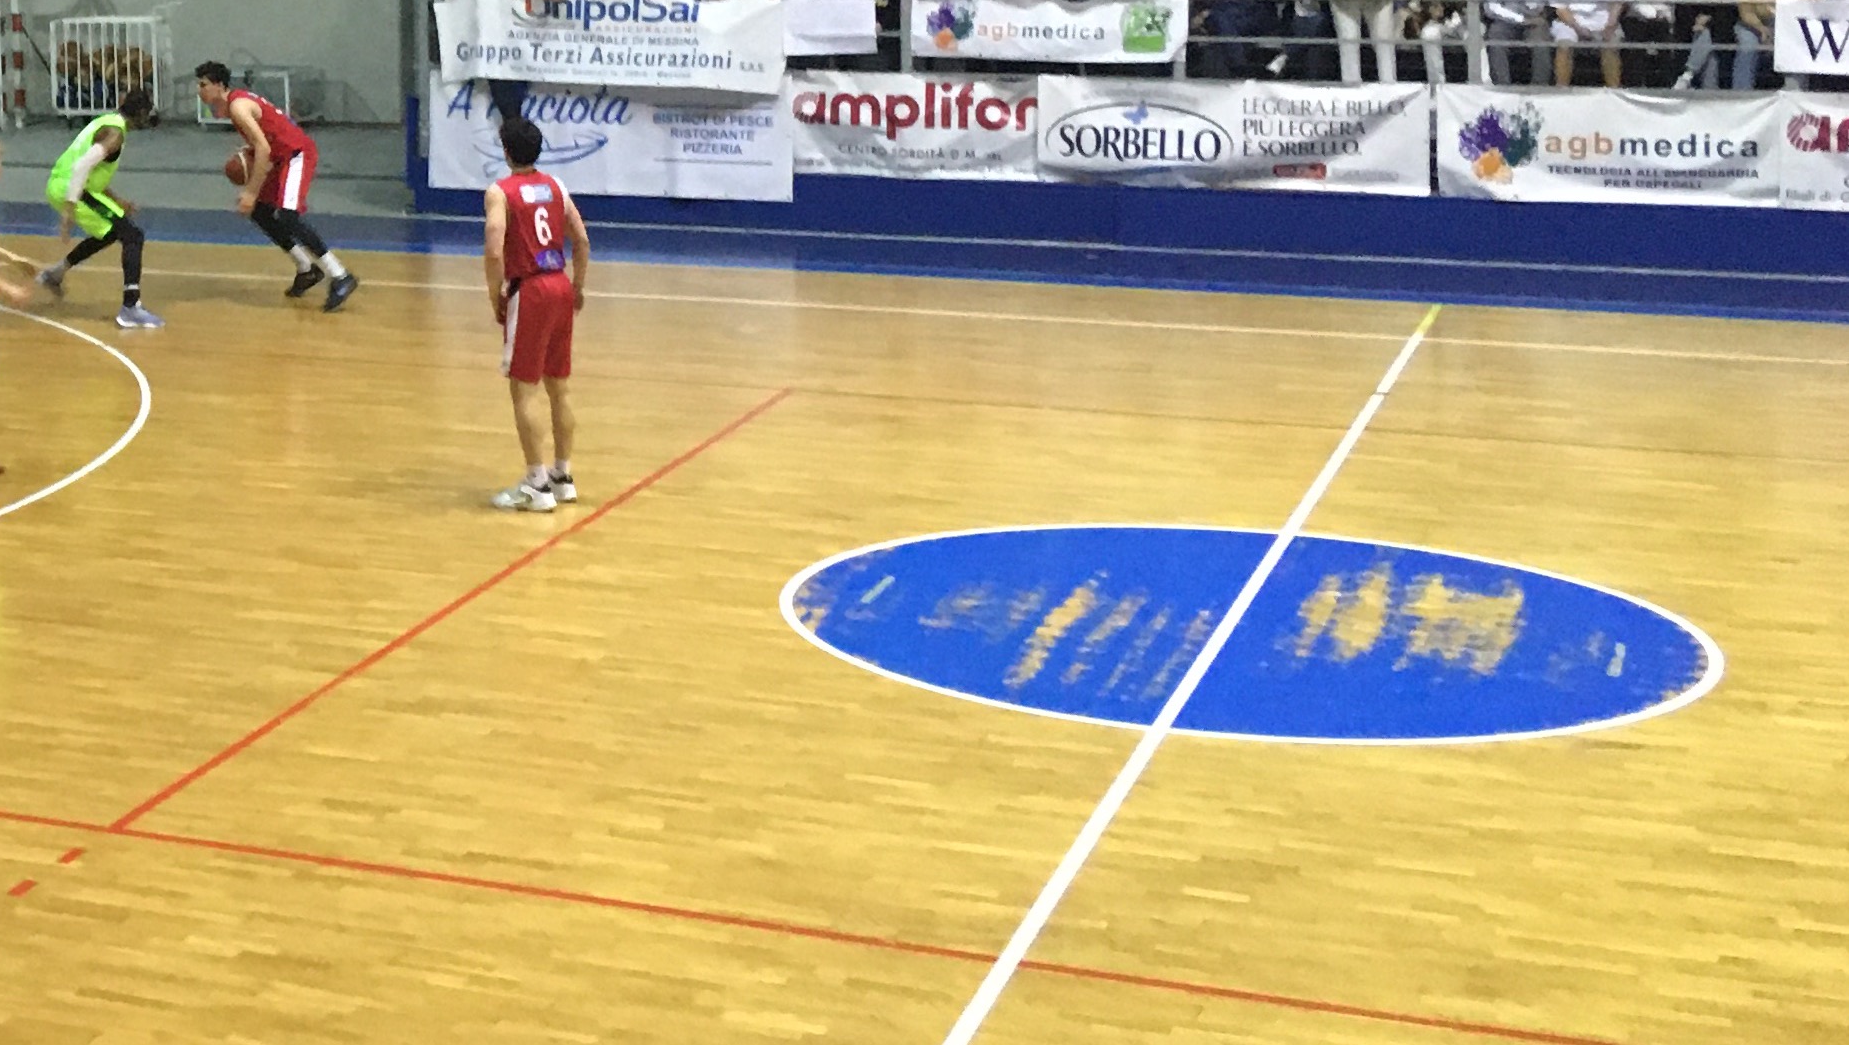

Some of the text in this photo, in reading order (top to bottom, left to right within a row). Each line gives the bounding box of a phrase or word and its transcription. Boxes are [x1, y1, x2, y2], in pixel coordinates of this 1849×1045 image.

[977, 22, 1105, 42] agbmedica
[456, 41, 522, 65] Gruppo
[530, 42, 582, 64] Terzi
[589, 46, 732, 70] Assicurazioni
[730, 115, 773, 127] PESCE
[1278, 119, 1366, 137] LEGGERA
[670, 127, 755, 142] RISTORANTE
[1058, 124, 1221, 163] SORBELLO
[682, 142, 743, 155] PIZZERIA
[1544, 131, 1759, 163] agbmedica
[534, 205, 553, 247] 6
